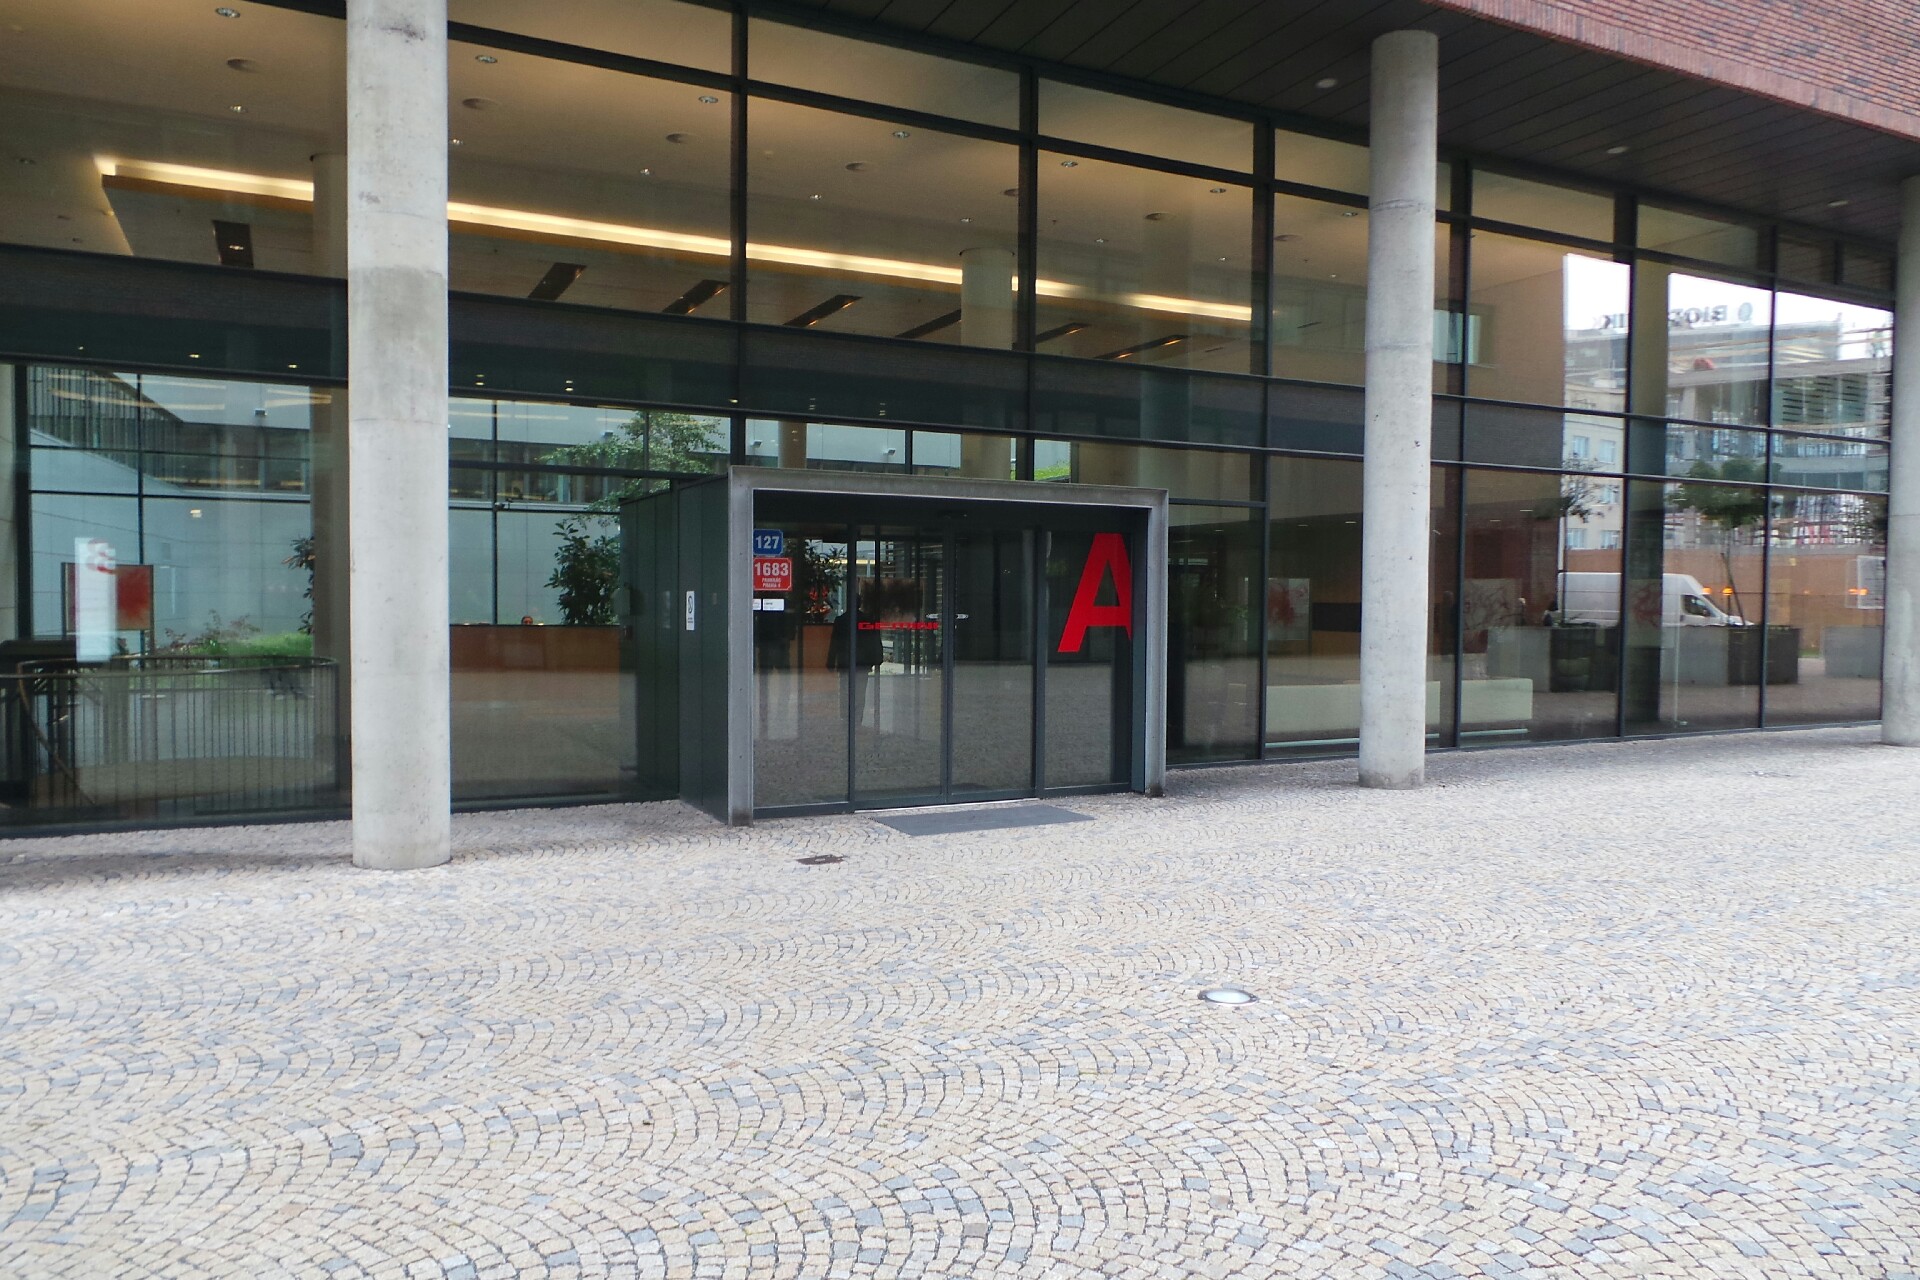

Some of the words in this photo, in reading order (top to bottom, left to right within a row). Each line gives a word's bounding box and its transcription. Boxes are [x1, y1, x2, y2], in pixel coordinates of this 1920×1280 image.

[755, 535, 780, 549] 127
[754, 562, 789, 576] 1683
[1057, 532, 1132, 652] A
